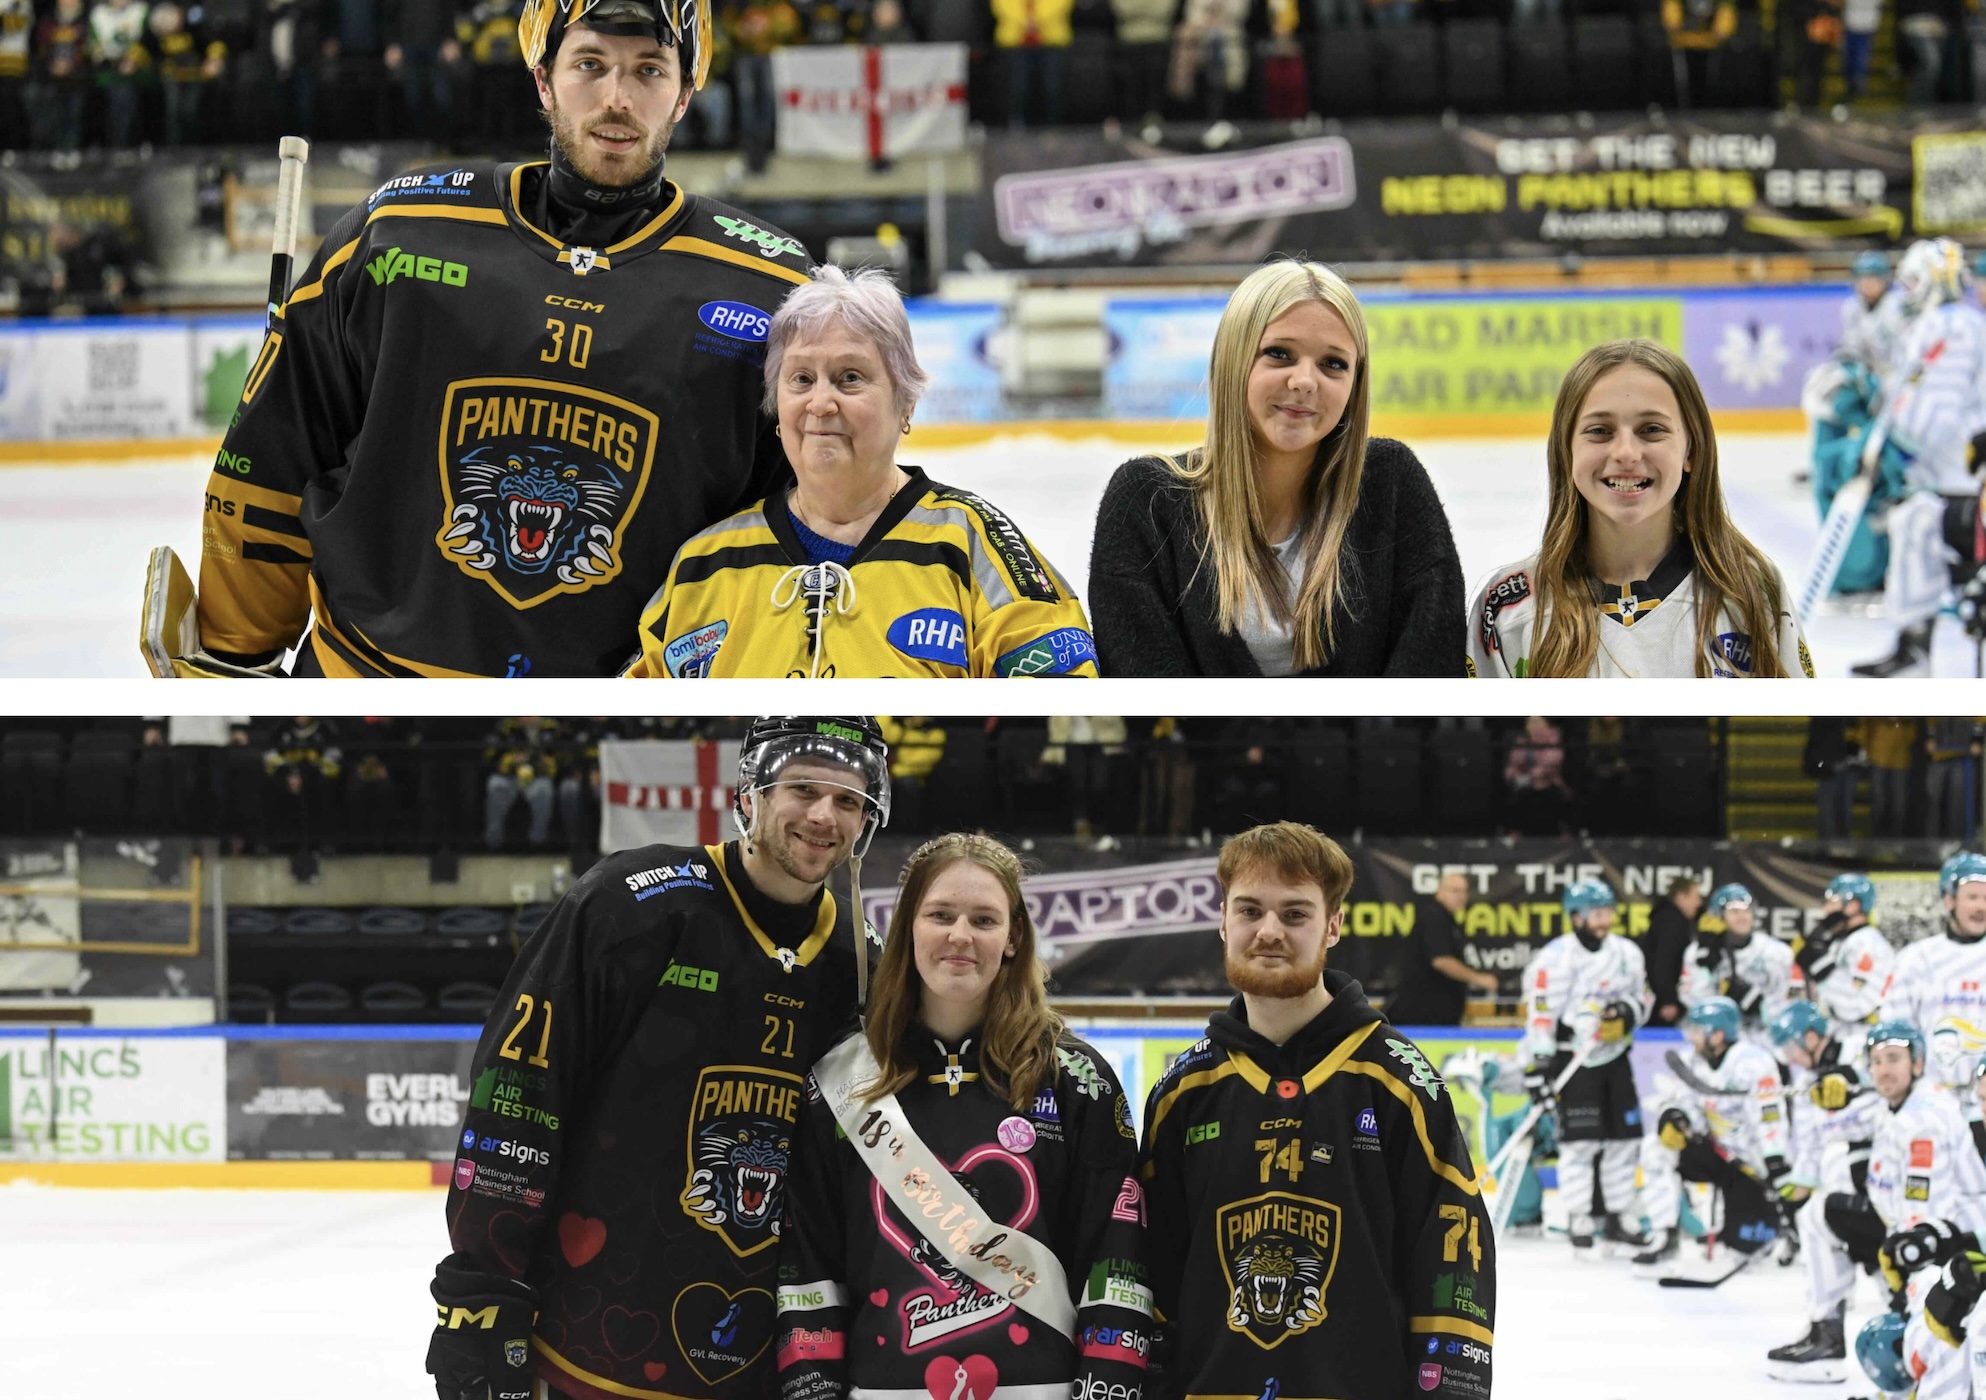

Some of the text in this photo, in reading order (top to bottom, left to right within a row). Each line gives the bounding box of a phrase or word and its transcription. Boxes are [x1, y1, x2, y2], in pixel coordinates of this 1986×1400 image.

[1496, 134, 1777, 173] GET THE NEW
[399, 186, 435, 196] Positive
[437, 187, 471, 197] Futures
[452, 172, 474, 187] UP
[1381, 169, 1887, 215] NEON PANTHERS BEER
[366, 246, 468, 288] WAGO
[544, 294, 606, 314] CCM
[710, 305, 769, 338] RHPS
[540, 318, 593, 370] 30
[456, 396, 639, 473] PANTHERS
[1005, 553, 1027, 587] ONLINE
[1059, 645, 1070, 666] of
[816, 722, 863, 743] WAGO
[625, 864, 708, 891] SWITCH UP
[635, 885, 665, 902] Building
[665, 879, 693, 890] Positive
[763, 993, 805, 1010] CCM
[499, 993, 553, 1069] 21
[761, 1015, 795, 1058] 21
[1194, 1038, 1211, 1052] UP
[19, 1048, 141, 1079] LINCS
[494, 1082, 522, 1102] AIR
[498, 1066, 547, 1092] LINCS
[21, 1085, 93, 1116] AIR
[366, 1100, 460, 1127] GYMS
[491, 1098, 560, 1131] TESTING
[1259, 1118, 1303, 1131] CCM
[20, 1122, 211, 1154] TESTING
[1000, 1119, 1035, 1148] 18
[480, 1136, 550, 1165] arsigns
[1254, 1138, 1304, 1184] 74
[458, 1166, 471, 1177] NBS
[476, 1164, 529, 1184] Nottingham
[474, 1175, 546, 1200] Business School
[858, 1110, 892, 1149] 18
[902, 1166, 1041, 1300] Birthday
[1111, 1176, 1148, 1228] 21
[1227, 1204, 1330, 1250] PANTHERS
[1439, 1204, 1482, 1273] 74
[1110, 1273, 1136, 1290] AIR
[1454, 1285, 1473, 1300] AIR
[1454, 1297, 1488, 1320] TESTING
[689, 1349, 747, 1366] GVL Recovery
[1446, 1341, 1490, 1364] arsigns
[1422, 1370, 1437, 1378] NBS
[1442, 1377, 1473, 1390] Business
[1444, 1367, 1481, 1382] Nottingham
[499, 1391, 530, 1400] CCM
